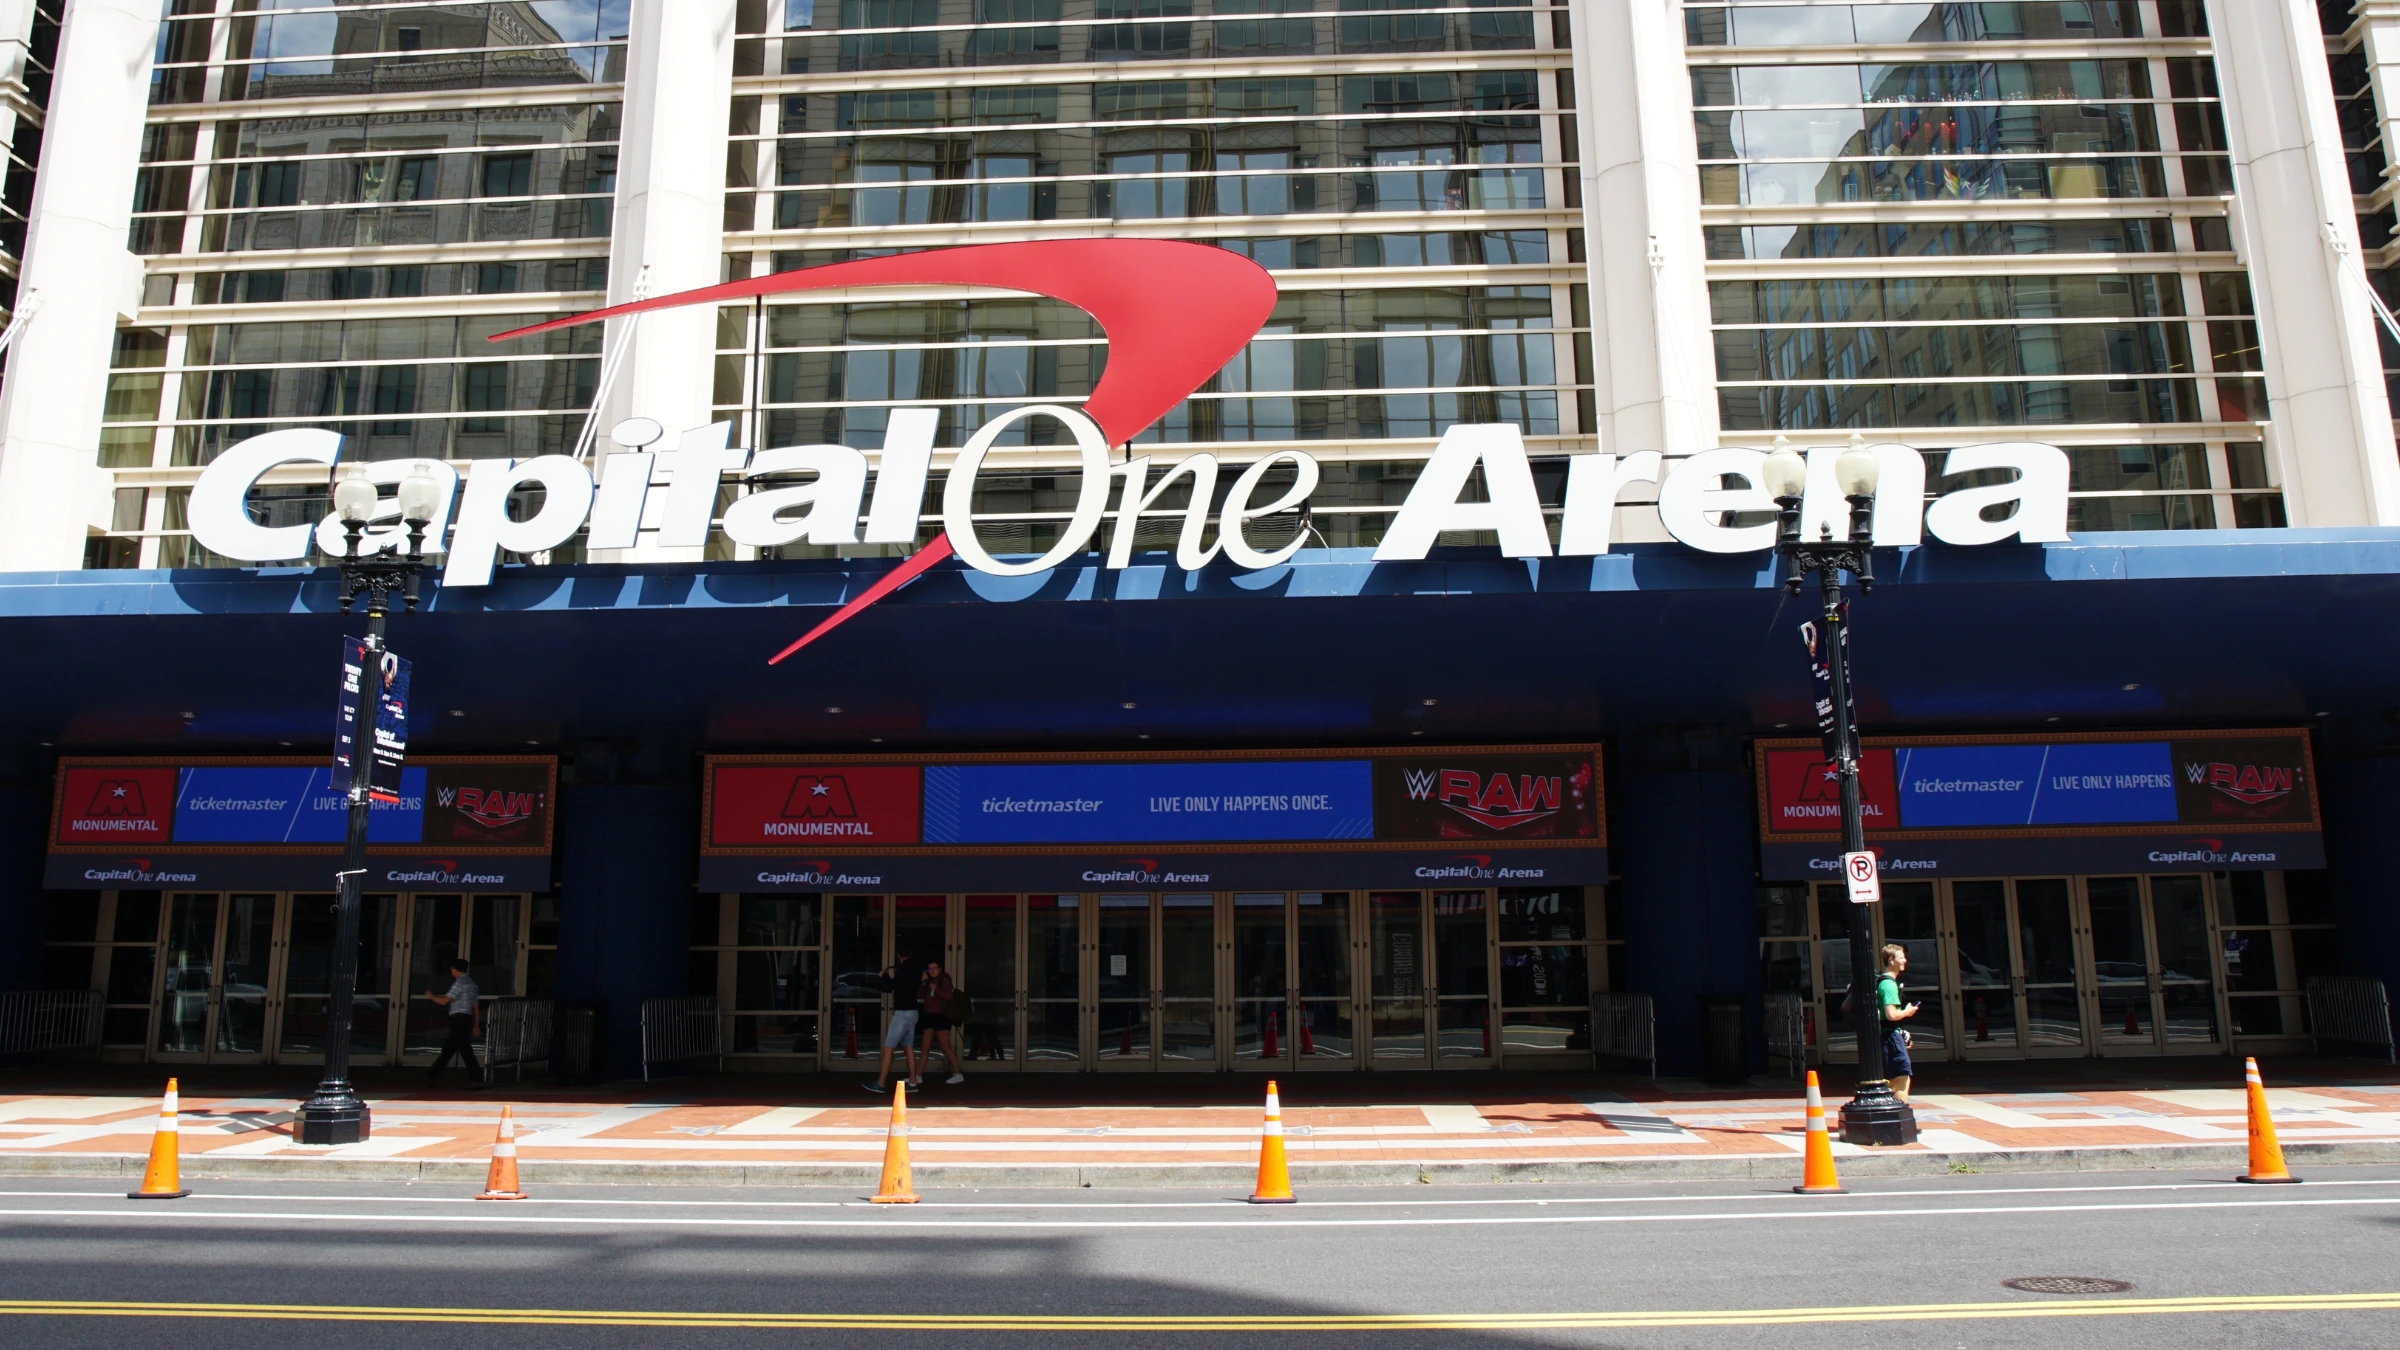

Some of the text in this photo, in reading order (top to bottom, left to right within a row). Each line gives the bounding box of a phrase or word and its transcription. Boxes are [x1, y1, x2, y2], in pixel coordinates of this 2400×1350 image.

[1371, 422, 2071, 560] Arena
[1914, 776, 2023, 793] ticketmaster
[2052, 774, 2172, 790] LIVE ONLY HAPPENS
[2209, 762, 2292, 793] RAW
[1439, 768, 1562, 813] RAW
[190, 796, 287, 810] ticketmaster
[313, 797, 339, 811] LIVE
[456, 786, 535, 817] RAW
[982, 796, 1104, 813] ticketmaster
[1150, 794, 1334, 812] LIVE ONLY HAPPENS ONCE.
[1783, 804, 1884, 818] MONUMTAL
[72, 819, 159, 831] MONUMENTAL
[764, 822, 874, 836] MONUMENTAL
[2230, 851, 2277, 862] Arena
[1891, 858, 1937, 870] Arena
[155, 871, 197, 882] Arena
[461, 872, 504, 884] Arena
[835, 873, 881, 885] Arena
[1162, 872, 1210, 884] Arena
[1497, 867, 1544, 878] Arena
